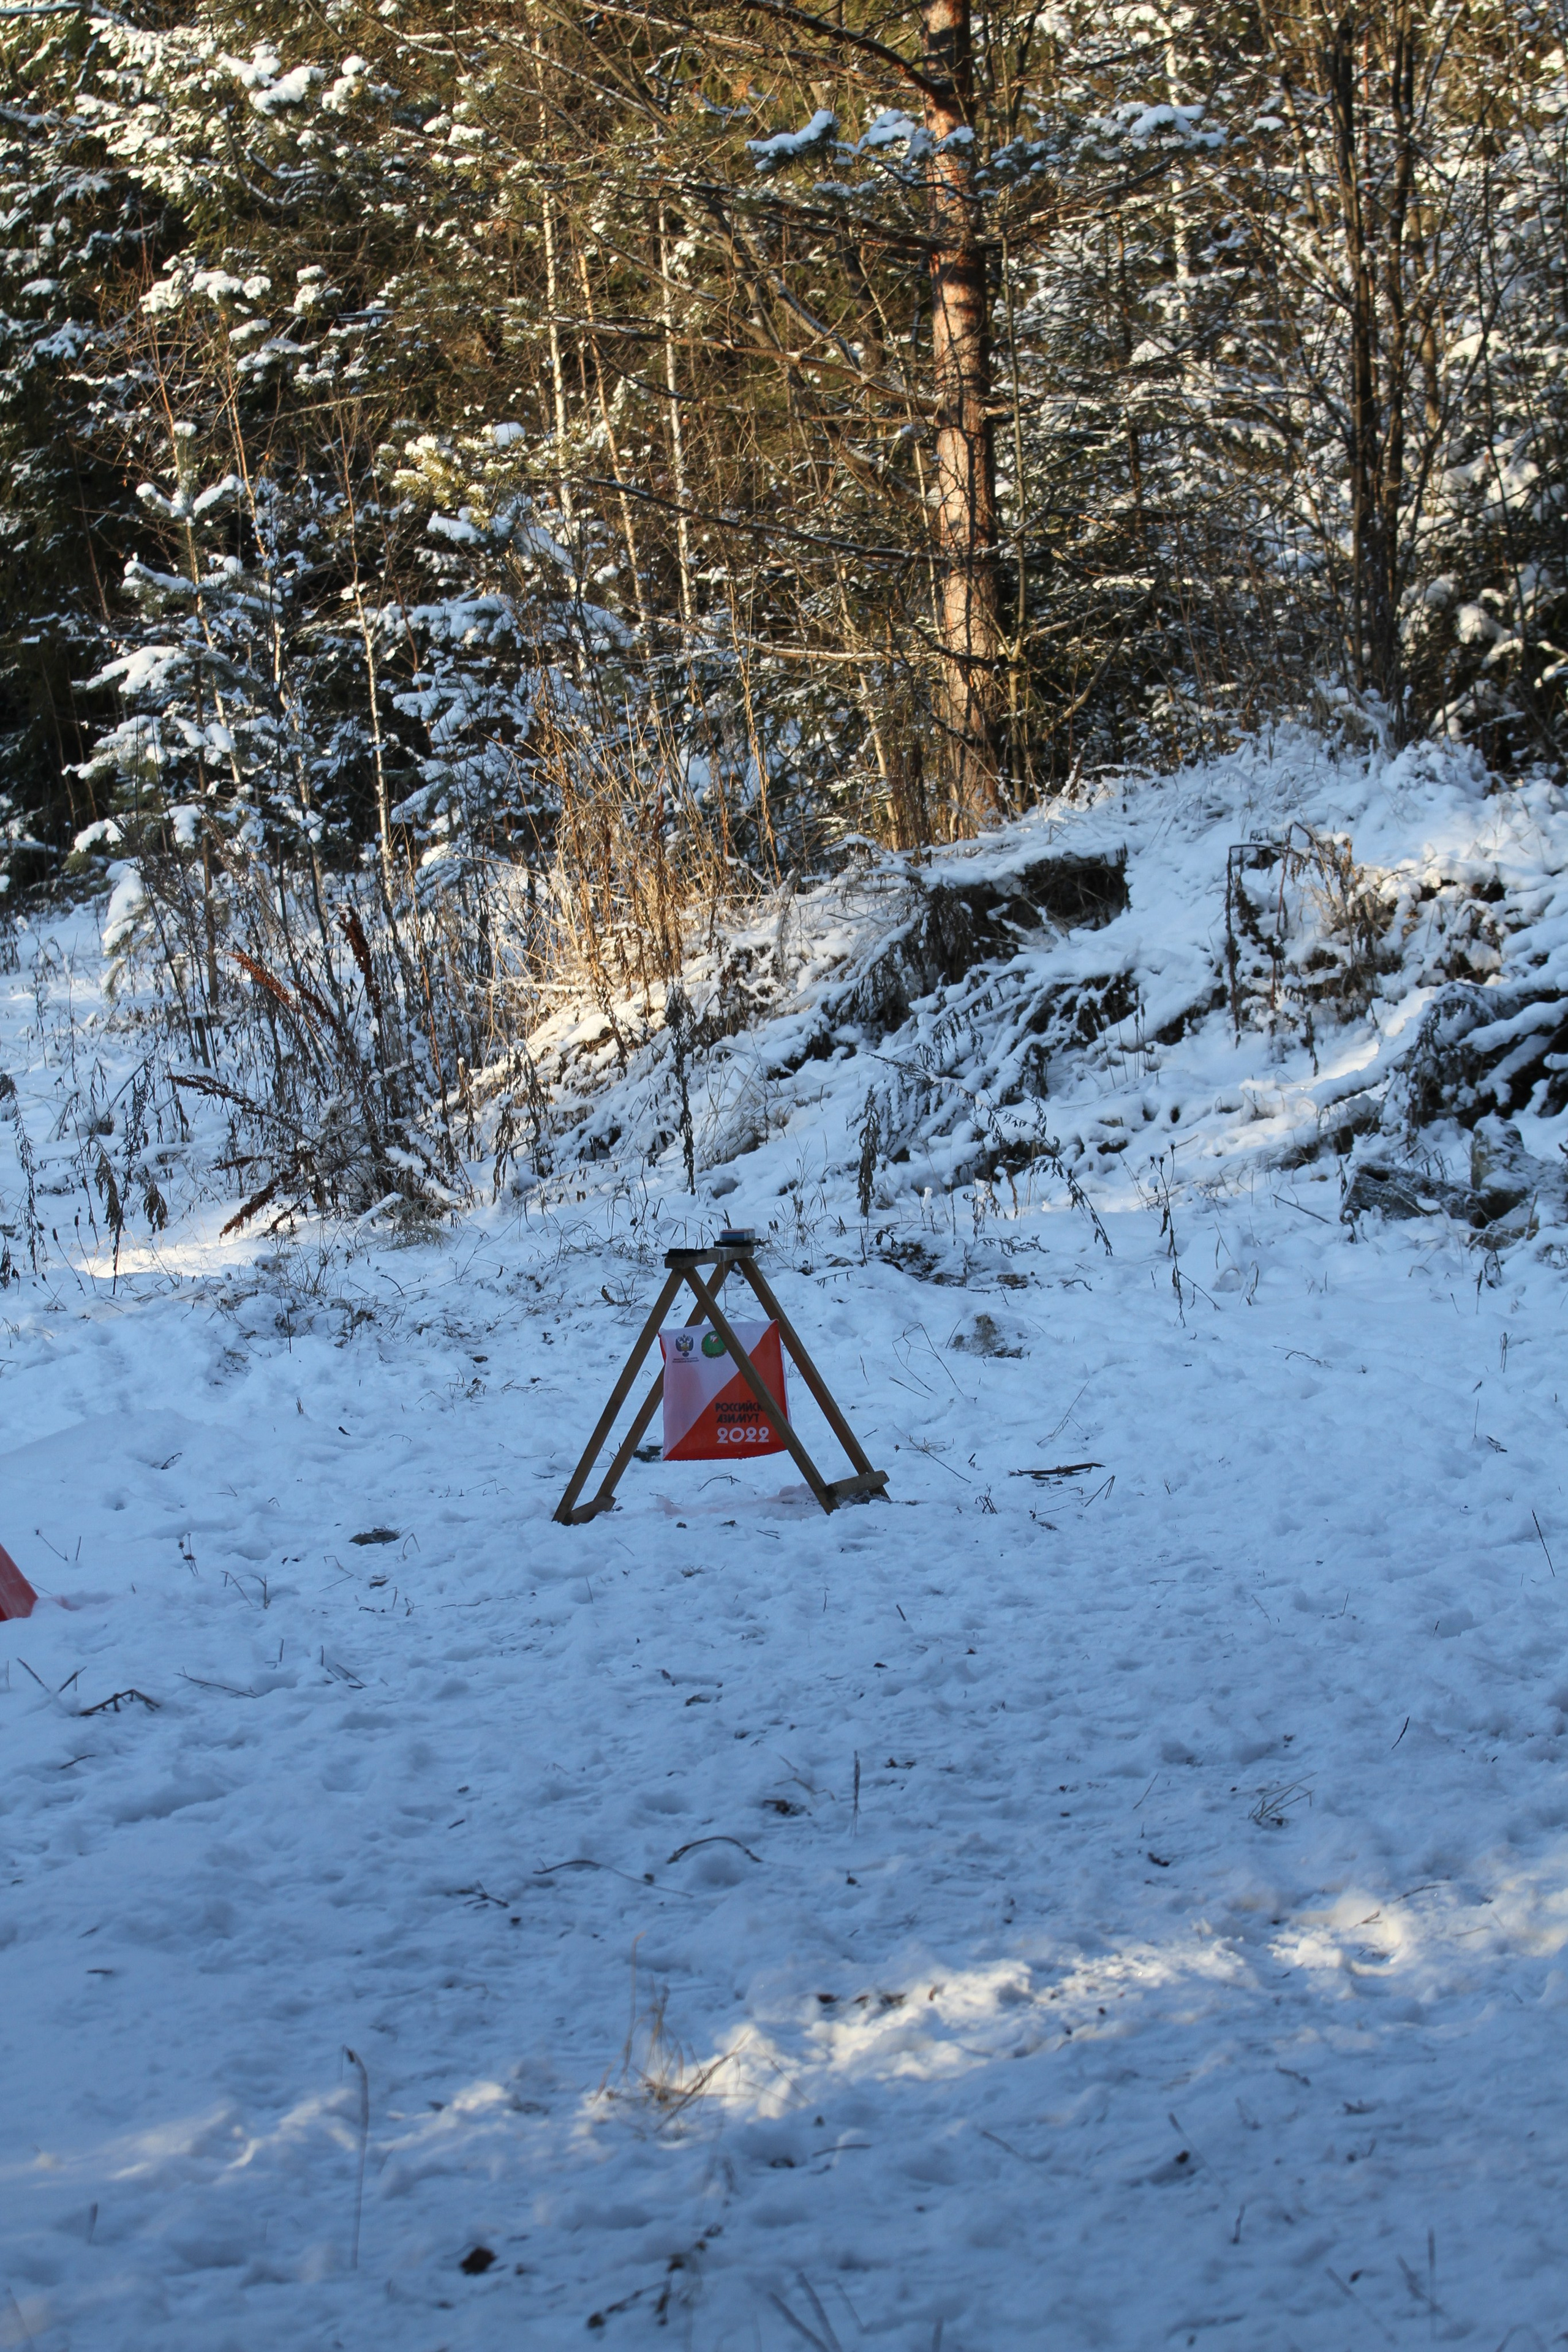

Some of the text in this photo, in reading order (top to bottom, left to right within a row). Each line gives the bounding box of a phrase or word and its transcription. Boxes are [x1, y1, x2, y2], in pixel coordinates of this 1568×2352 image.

[715, 1400, 763, 1412] РОССИЙСК
[716, 1413, 759, 1423] АЗИМУТ
[717, 1427, 769, 1444] 2022
